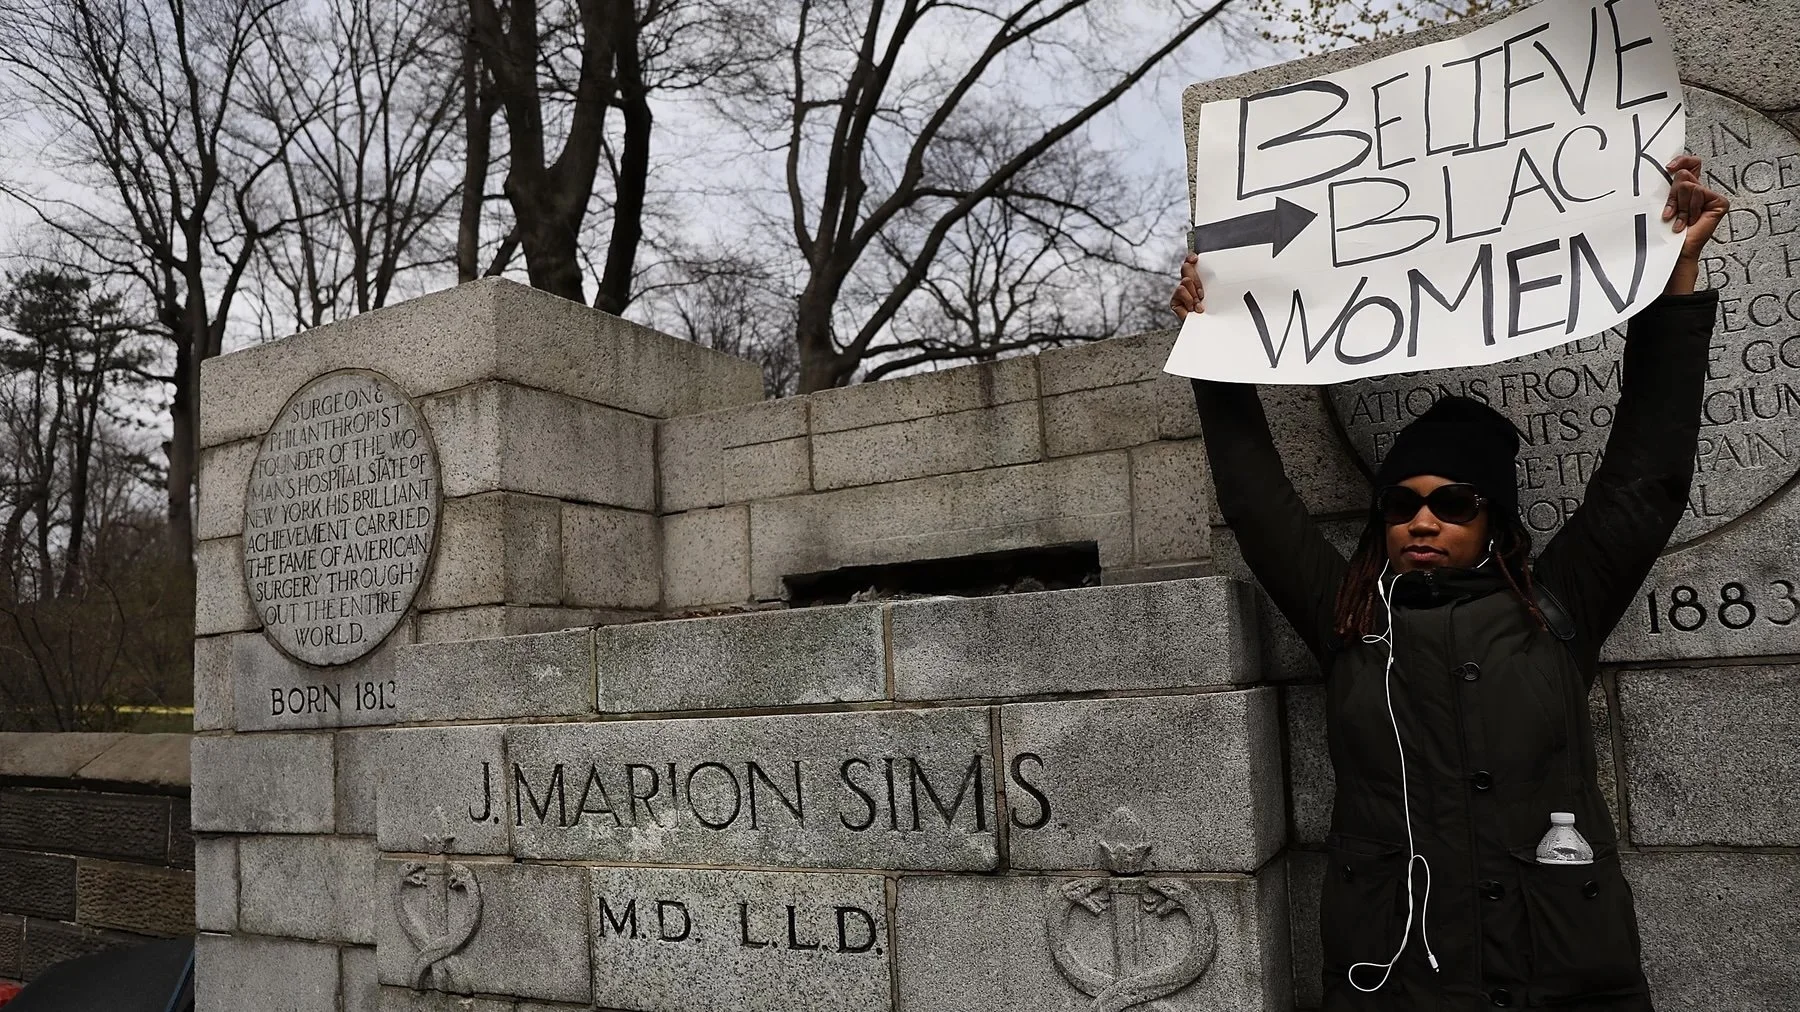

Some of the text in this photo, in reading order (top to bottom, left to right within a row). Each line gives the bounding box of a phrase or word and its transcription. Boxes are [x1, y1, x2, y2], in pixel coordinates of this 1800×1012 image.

[1237, 0, 1668, 200] BELIEVE
[1328, 103, 1681, 268] BLACK
[1243, 213, 1646, 367] WOMEN
[291, 387, 371, 424] SURGEON
[1499, 360, 1623, 408] FROM
[269, 403, 404, 452] PHILANTHROPIST
[1696, 428, 1791, 473] PAIN
[258, 448, 326, 479] FOUNDER
[329, 442, 349, 464] OF
[352, 434, 386, 460] THE
[298, 464, 365, 497] HOSPITAL
[368, 456, 408, 484] STATE
[410, 453, 428, 475] OF
[244, 478, 433, 530] NEW YORK HIS BRILLIANT
[246, 506, 431, 555] ACHIEVEMENT CARRIED
[247, 532, 428, 579] THE FAME OF AMERICAN
[256, 573, 323, 602] SURGERY
[264, 590, 402, 626] OUT THE ENTIRE
[1647, 579, 1800, 635] 1883
[295, 622, 367, 648] WORLD.
[270, 683, 341, 716] BORN
[468, 761, 501, 825] J.
[513, 760, 804, 832] MARION
[598, 896, 883, 956] M.D. L.L.D.
